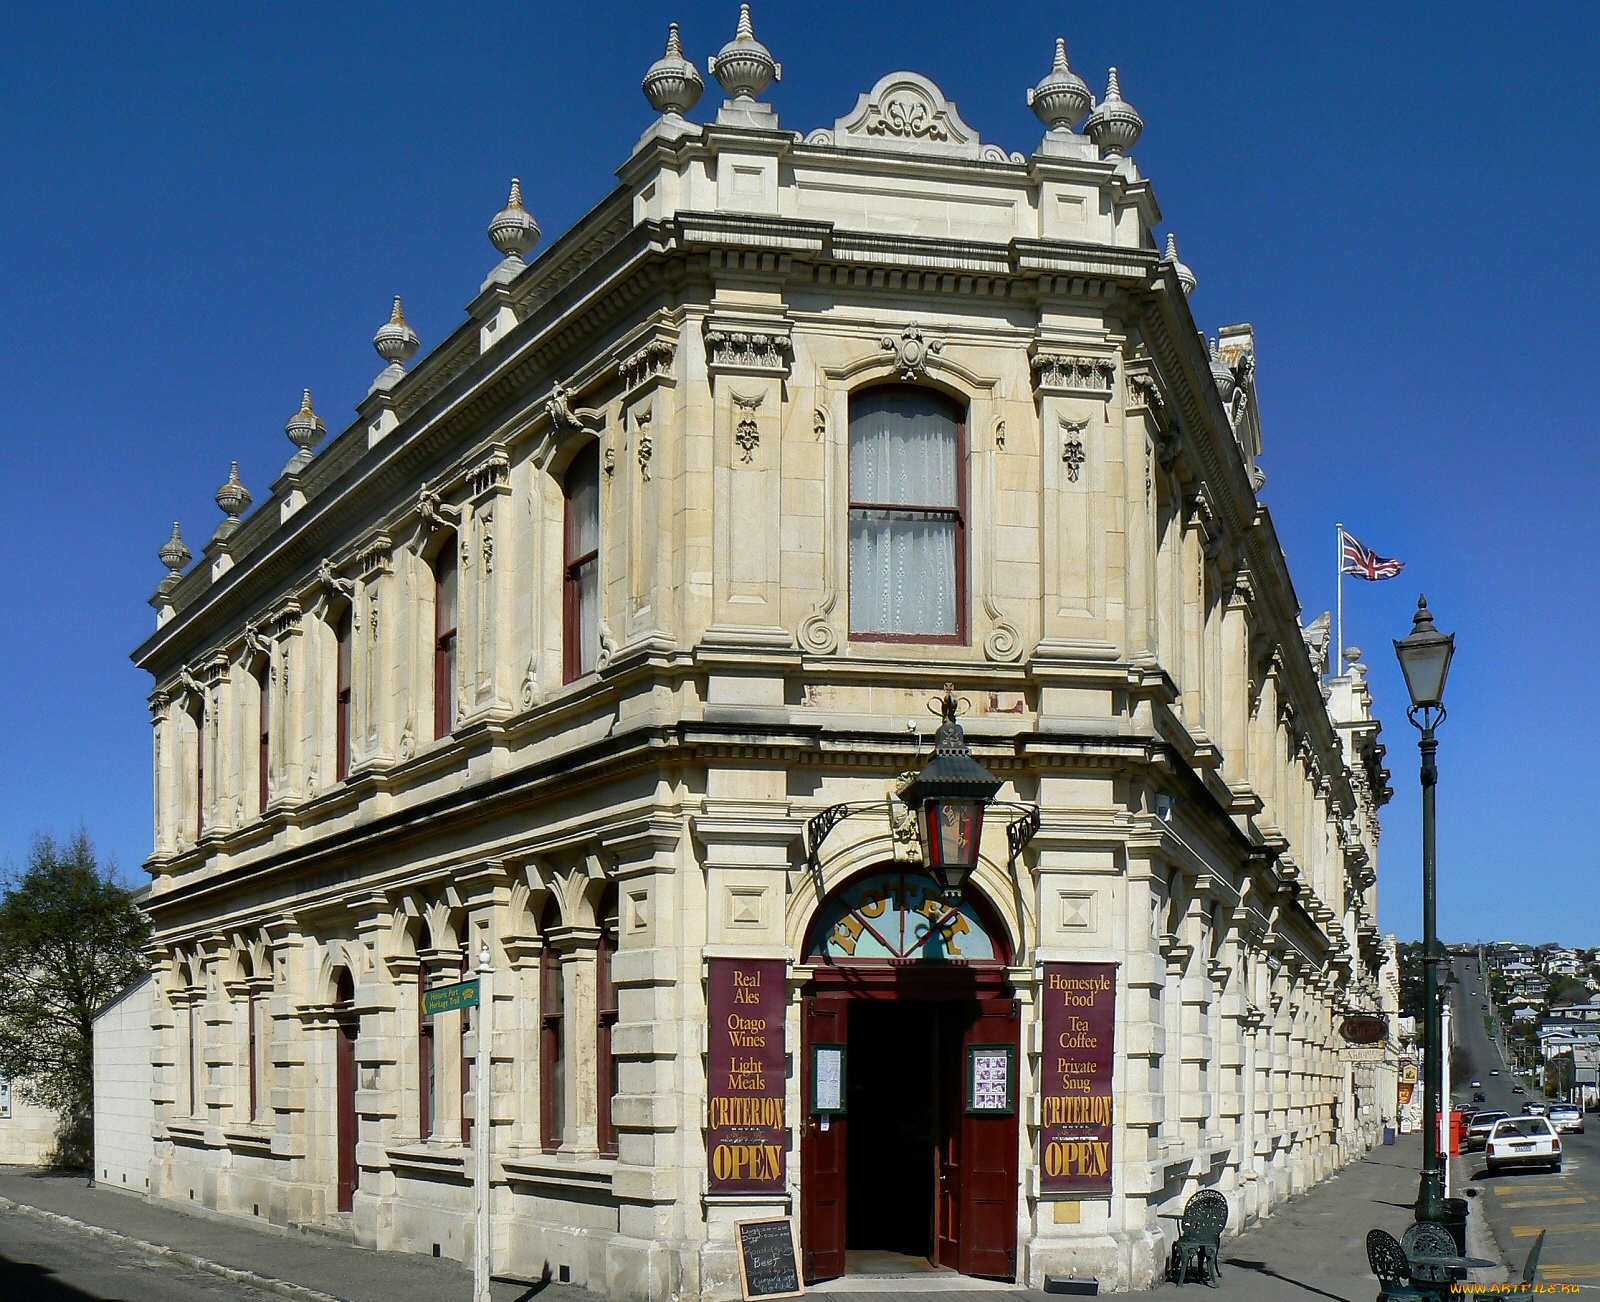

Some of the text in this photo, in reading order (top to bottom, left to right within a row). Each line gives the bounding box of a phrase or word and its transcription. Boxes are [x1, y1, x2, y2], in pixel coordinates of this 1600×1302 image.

[829, 881, 971, 956] HOTEL
[733, 970, 760, 987] Real
[1049, 974, 1110, 993] Homestyle
[430, 996, 460, 1009] Heritage Trail
[734, 986, 760, 1004] Ales
[1064, 990, 1095, 1007] Food
[727, 1013, 766, 1036] Otago
[1068, 1016, 1089, 1032] Tea
[728, 1030, 766, 1048] Wines
[1059, 1032, 1097, 1049] Coffee
[730, 1056, 763, 1079] Light
[1057, 1058, 1097, 1074] Private
[728, 1074, 766, 1090] Meals
[1062, 1075, 1091, 1093] Snug
[710, 1096, 784, 1131] CRITERION
[1043, 1095, 1111, 1129] CRITERION
[712, 1144, 783, 1182] OPEN
[1044, 1141, 1110, 1178] OPEN
[753, 1253, 780, 1269] Beef
